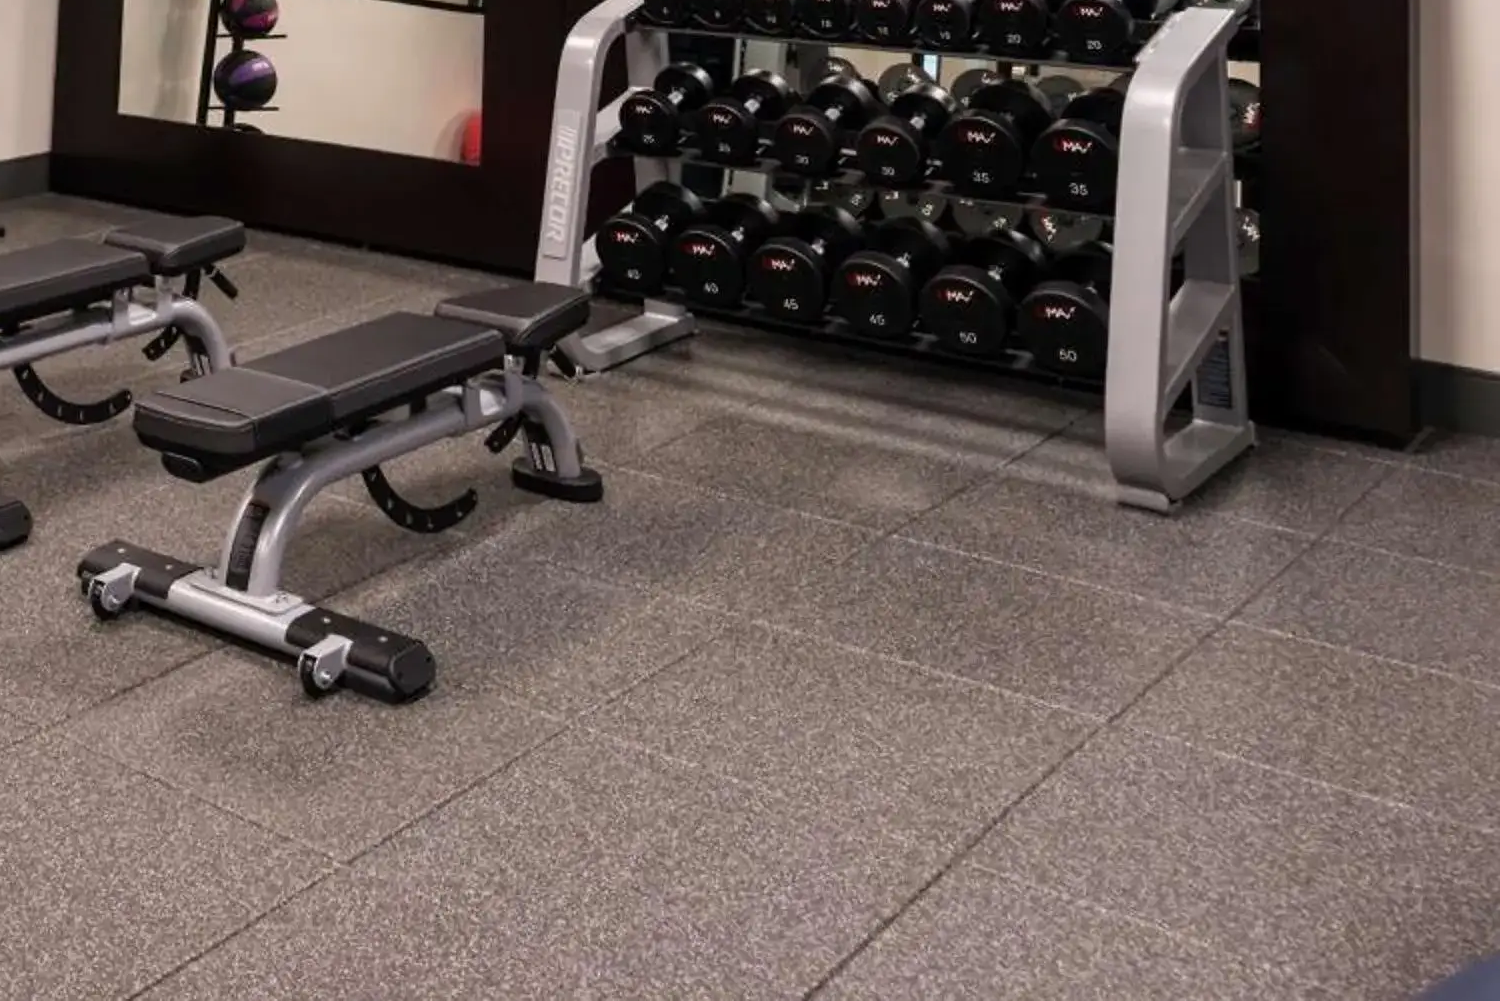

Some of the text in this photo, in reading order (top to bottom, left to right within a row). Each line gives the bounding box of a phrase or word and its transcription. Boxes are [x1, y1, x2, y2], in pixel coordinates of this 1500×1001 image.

[546, 135, 575, 245] PRECOR
[1068, 182, 1089, 196] 35
[783, 298, 799, 310] 45
